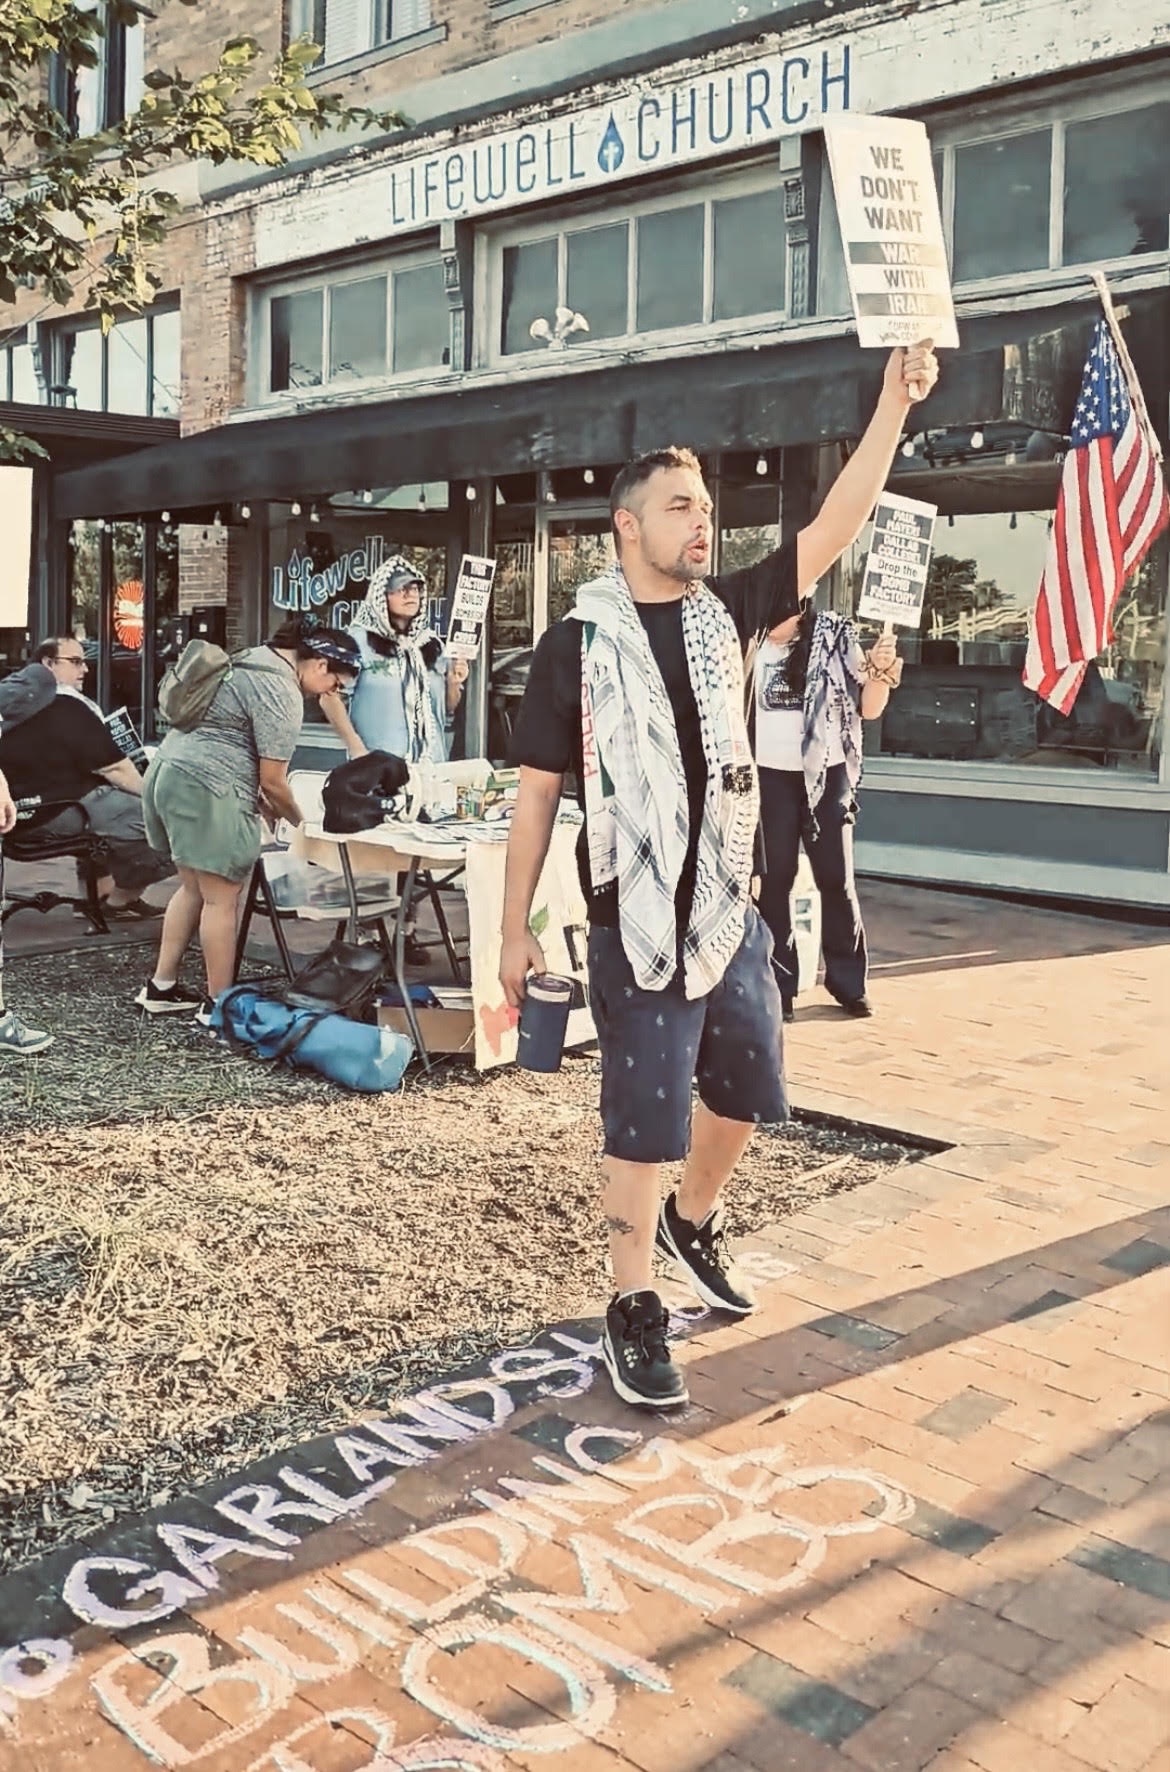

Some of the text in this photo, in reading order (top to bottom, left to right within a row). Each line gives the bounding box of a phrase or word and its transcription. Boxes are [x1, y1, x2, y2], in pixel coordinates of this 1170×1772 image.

[638, 45, 850, 161] CHURCH
[870, 146, 904, 171] WE
[861, 176, 919, 202] DON'T
[865, 206, 923, 233] WANT
[880, 242, 919, 265] WAR
[883, 269, 926, 289] WITH
[273, 535, 384, 611] Lifewell
[879, 559, 918, 578] Drop the
[870, 585, 917, 606] FACTORY
[90, 1424, 684, 1768] BUILDING
